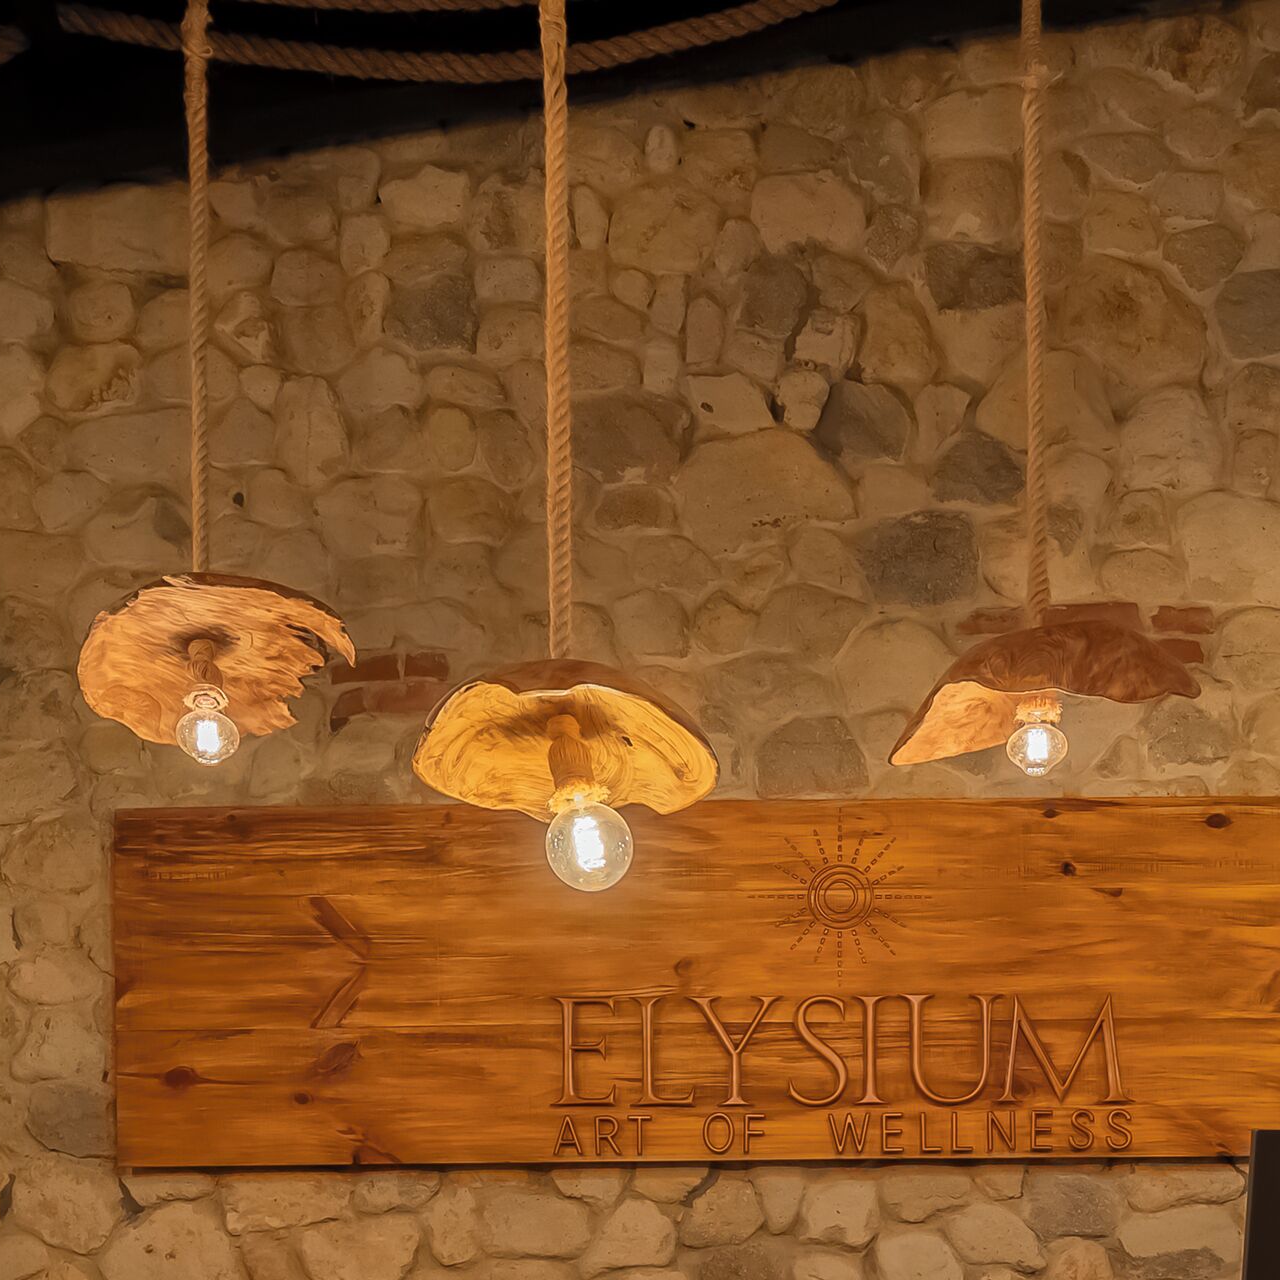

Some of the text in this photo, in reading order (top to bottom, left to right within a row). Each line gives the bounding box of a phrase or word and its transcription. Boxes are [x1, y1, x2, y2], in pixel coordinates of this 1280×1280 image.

[549, 993, 1136, 1107] ELYSIUM
[552, 1107, 1135, 1156] ART OF WELLNESS
